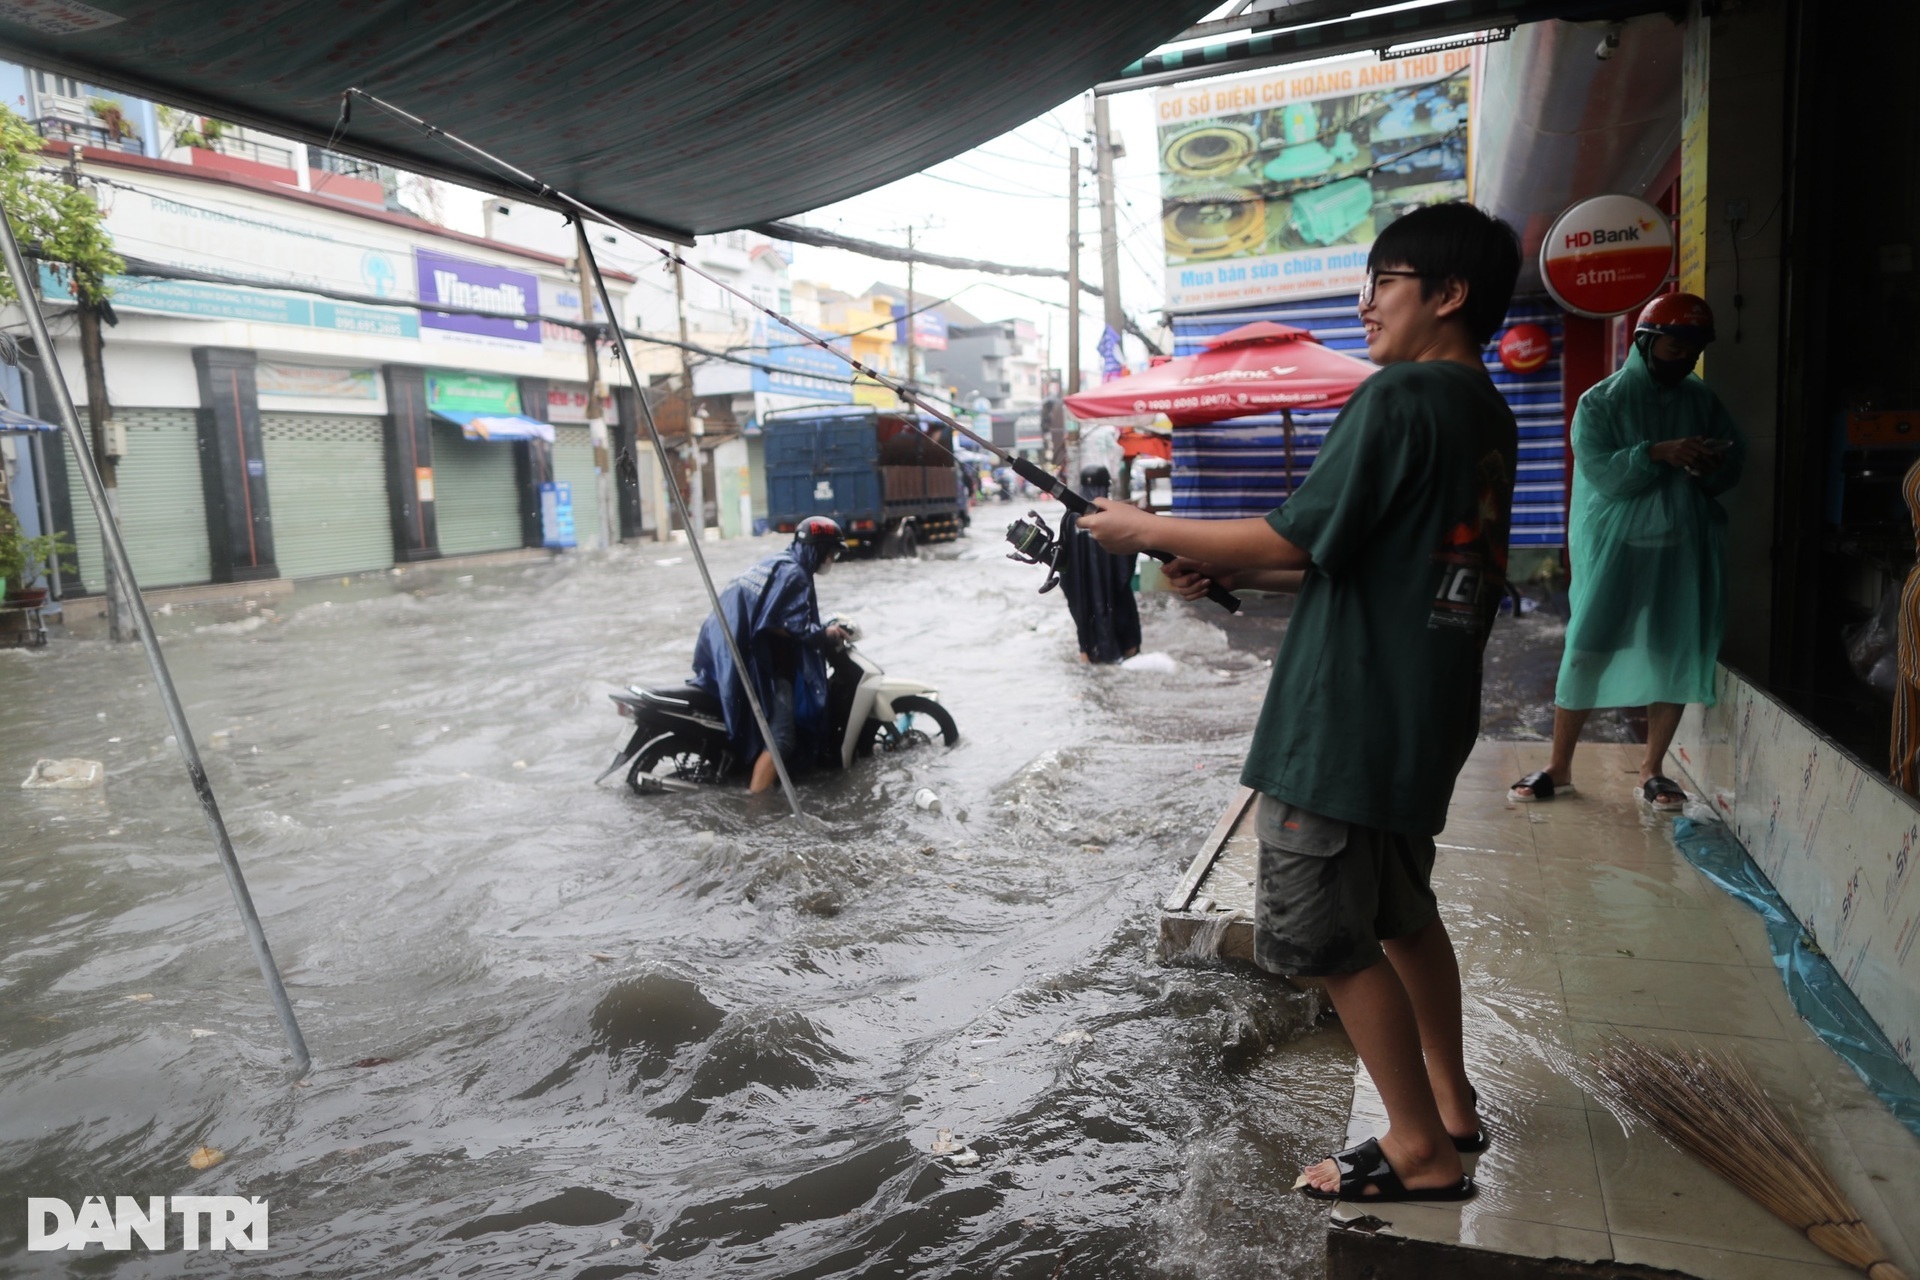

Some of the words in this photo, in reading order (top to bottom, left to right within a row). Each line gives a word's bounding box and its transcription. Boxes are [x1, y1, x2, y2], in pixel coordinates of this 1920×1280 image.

[1160, 96, 1183, 121] CƠ
[1215, 84, 1257, 113] ĐIỆN
[1262, 80, 1286, 103] CƠ
[1291, 69, 1351, 98] HOÀNG
[1358, 62, 1396, 89] ANH
[1565, 226, 1640, 249] HDBank
[1180, 270, 1214, 288] Mua
[1218, 264, 1247, 283] bán
[1576, 267, 1616, 286] atm
[433, 269, 527, 317] Vinamilk
